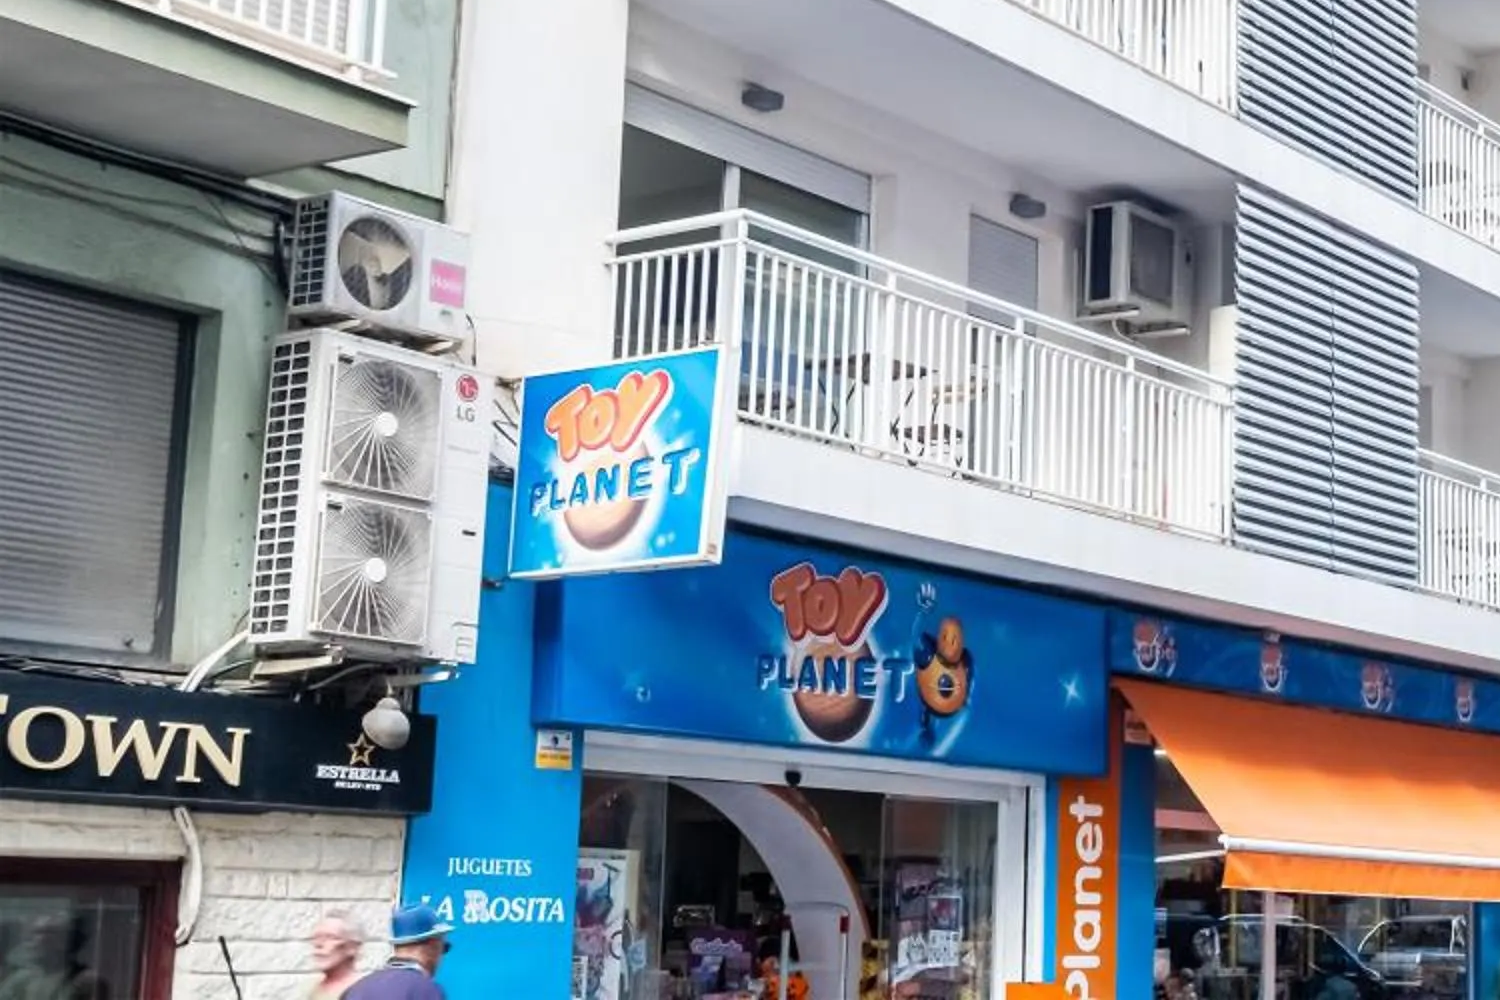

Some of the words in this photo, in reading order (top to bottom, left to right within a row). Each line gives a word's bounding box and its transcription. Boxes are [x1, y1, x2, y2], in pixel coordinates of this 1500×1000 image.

[456, 405, 476, 423] LG
[545, 368, 674, 463] TOY
[528, 448, 700, 519] PLANET
[770, 562, 888, 651] TOY
[756, 653, 915, 703] PLANET
[0, 694, 252, 787] OWN
[315, 764, 400, 783] ESTRELLA
[447, 857, 533, 877] JUGUETES
[420, 894, 454, 922] A
